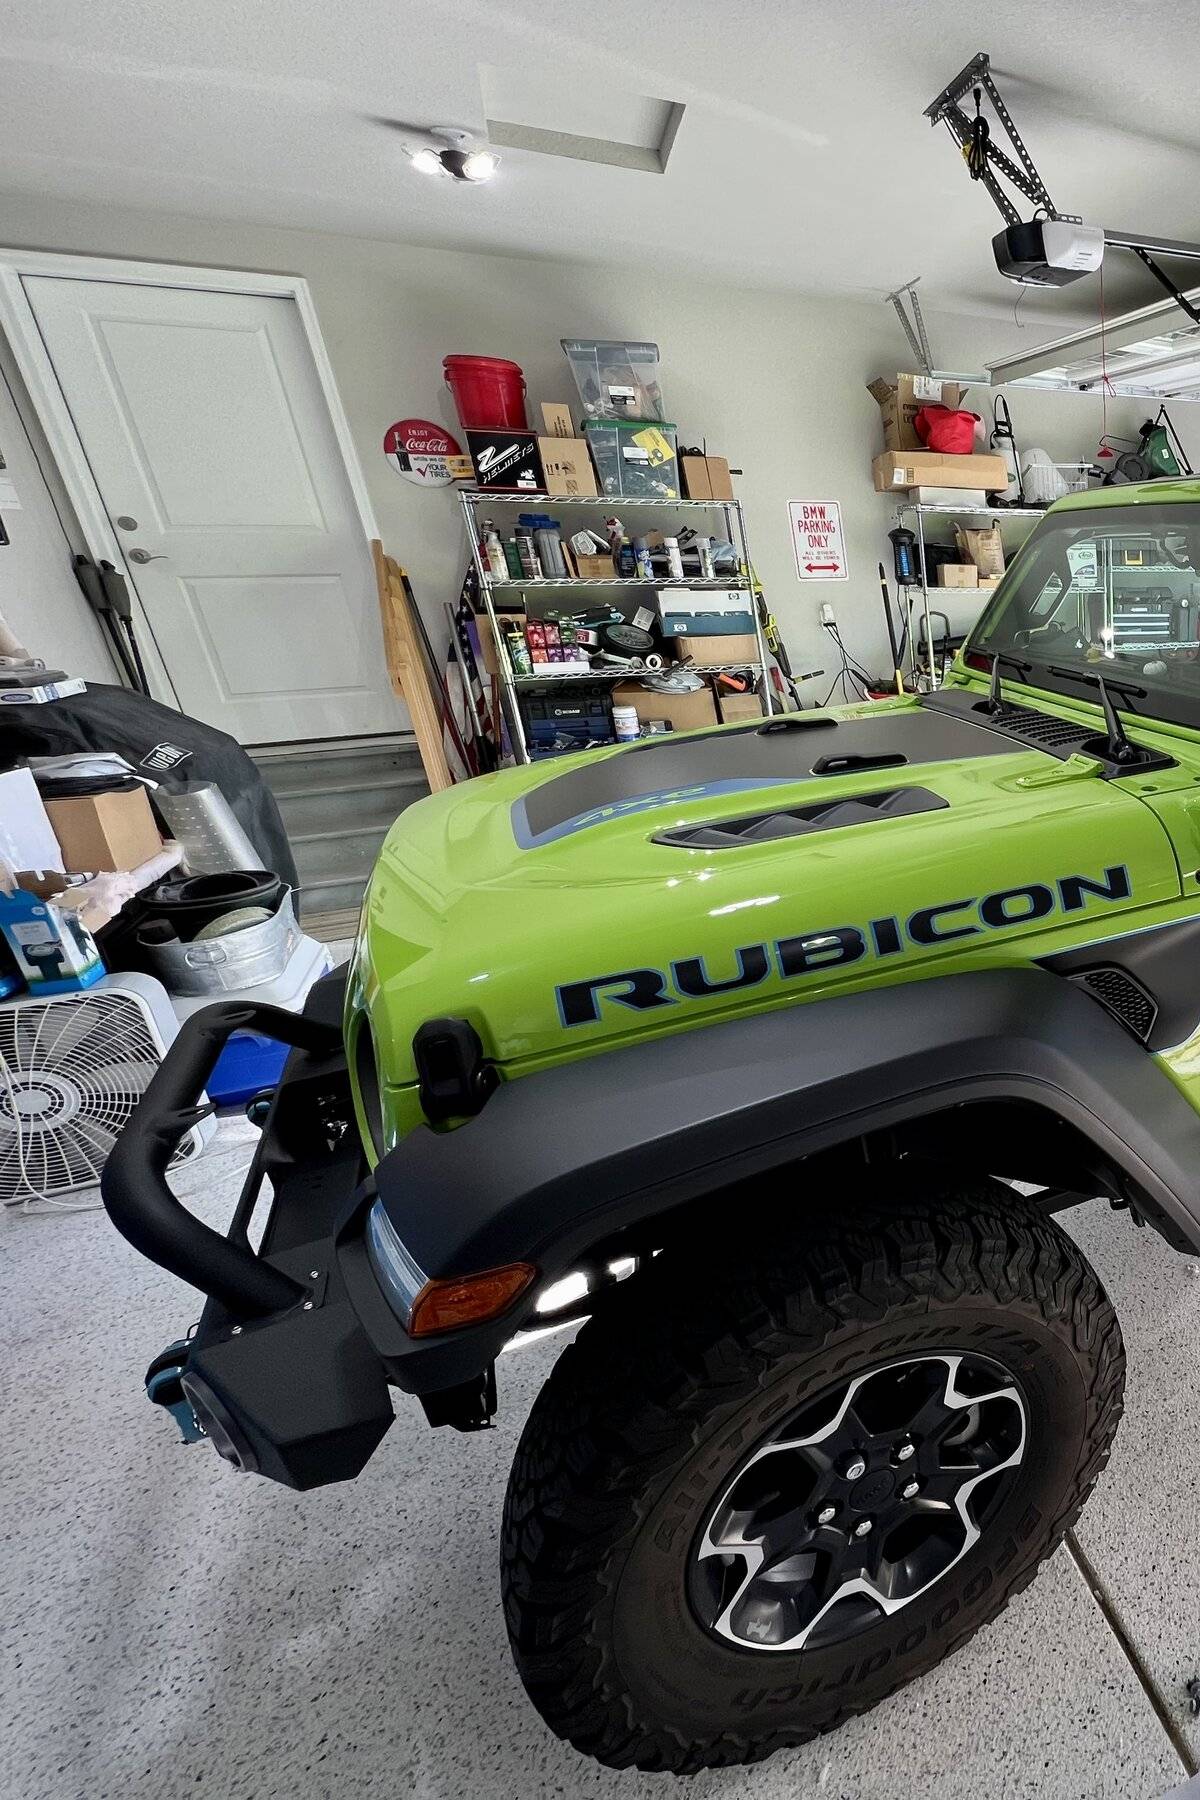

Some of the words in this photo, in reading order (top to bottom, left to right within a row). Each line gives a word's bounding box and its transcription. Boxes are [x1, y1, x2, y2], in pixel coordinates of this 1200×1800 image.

[406, 438, 448, 452] Coca-Cola
[428, 463, 447, 471] YOUR
[429, 470, 451, 478] TIRES
[802, 505, 826, 519] BMW
[797, 520, 836, 533] PARKING
[807, 534, 829, 548] ONLY
[148, 746, 184, 769] weber
[554, 864, 1134, 1029] RUBICON
